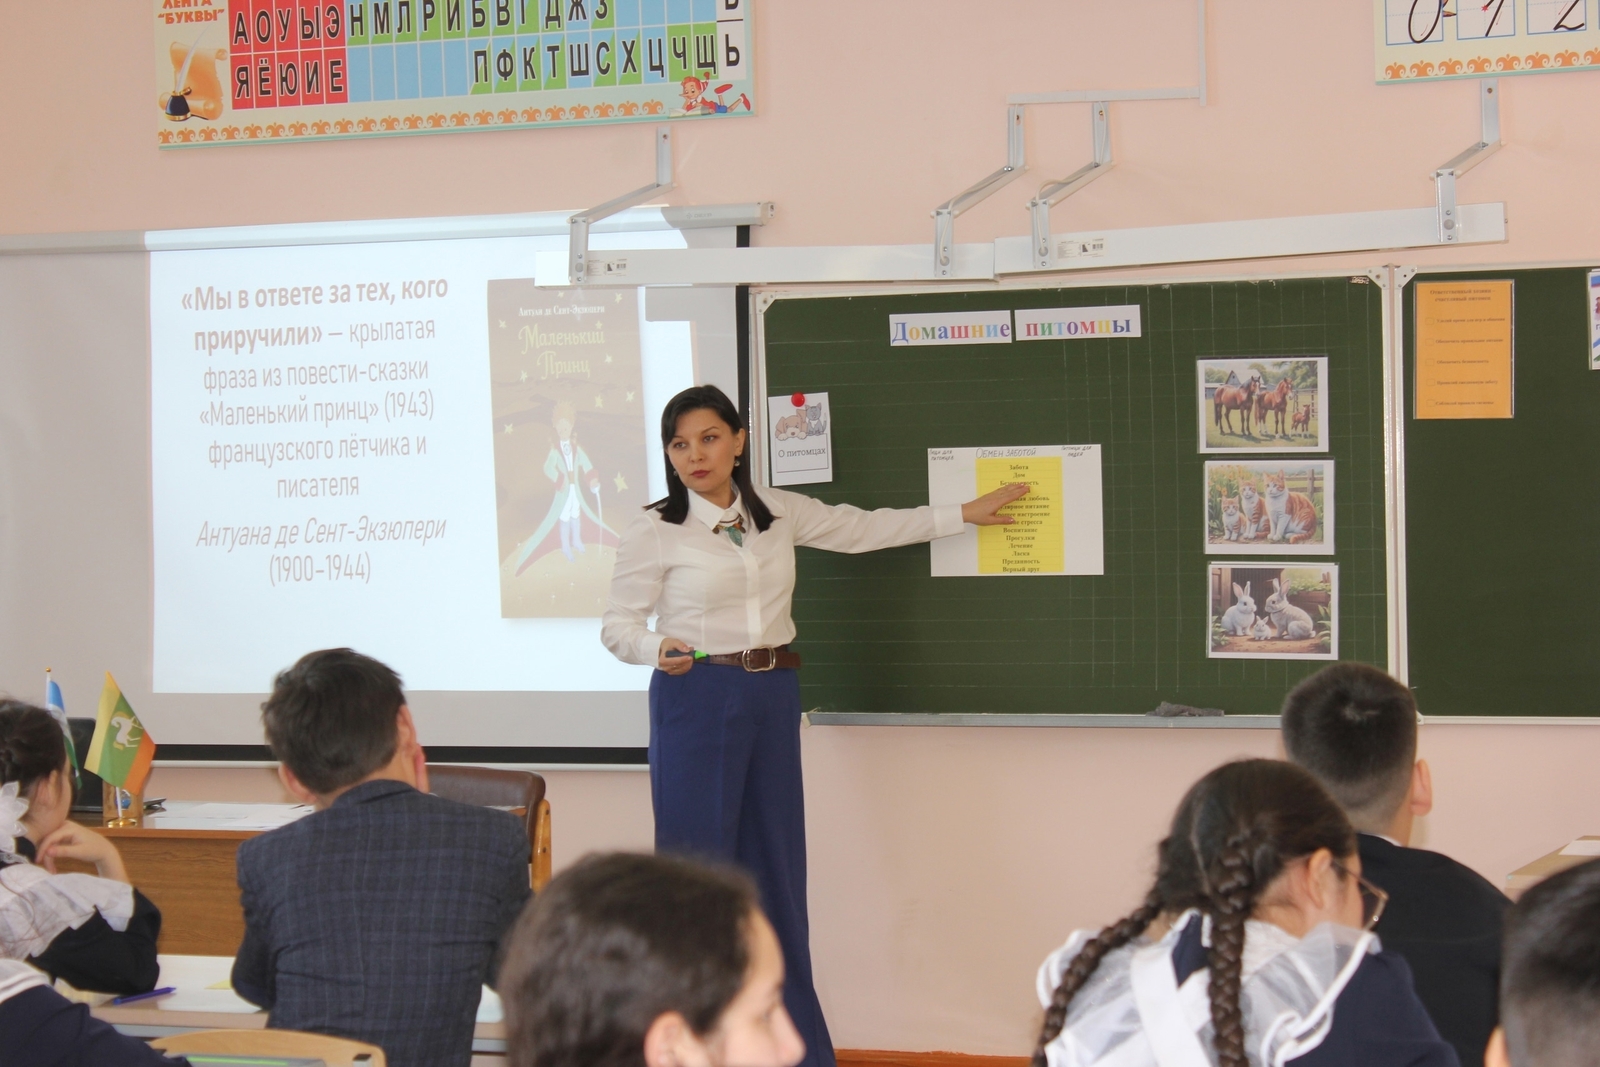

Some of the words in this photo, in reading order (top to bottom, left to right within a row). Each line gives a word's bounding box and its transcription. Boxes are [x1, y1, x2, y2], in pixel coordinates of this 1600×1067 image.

[181, 286, 231, 311] «Мы
[238, 289, 249, 309] в
[255, 285, 323, 308] ответе
[328, 284, 350, 303] за
[356, 281, 396, 305] тех,
[401, 278, 448, 299] кого
[194, 325, 322, 356] приручили»
[350, 320, 435, 349] крылатая
[518, 323, 605, 354] Маленький
[892, 322, 1010, 344] Домашние
[1025, 319, 1131, 337] питомцы
[203, 366, 257, 395] фраза
[263, 367, 282, 387] из
[287, 360, 429, 387] повести-сказки
[537, 351, 591, 380] Принц
[199, 394, 308, 426] «Маленький
[314, 400, 379, 428] принц»
[384, 388, 434, 423] (1943)
[209, 440, 333, 470] французского
[338, 433, 410, 458] лётчика
[417, 436, 427, 455] и
[778, 449, 785, 458] О
[786, 448, 826, 458] питомцах
[277, 476, 359, 498] писателя
[196, 520, 271, 553] Антуана
[275, 524, 299, 548] де
[304, 515, 447, 546] Сент-Экзюпери
